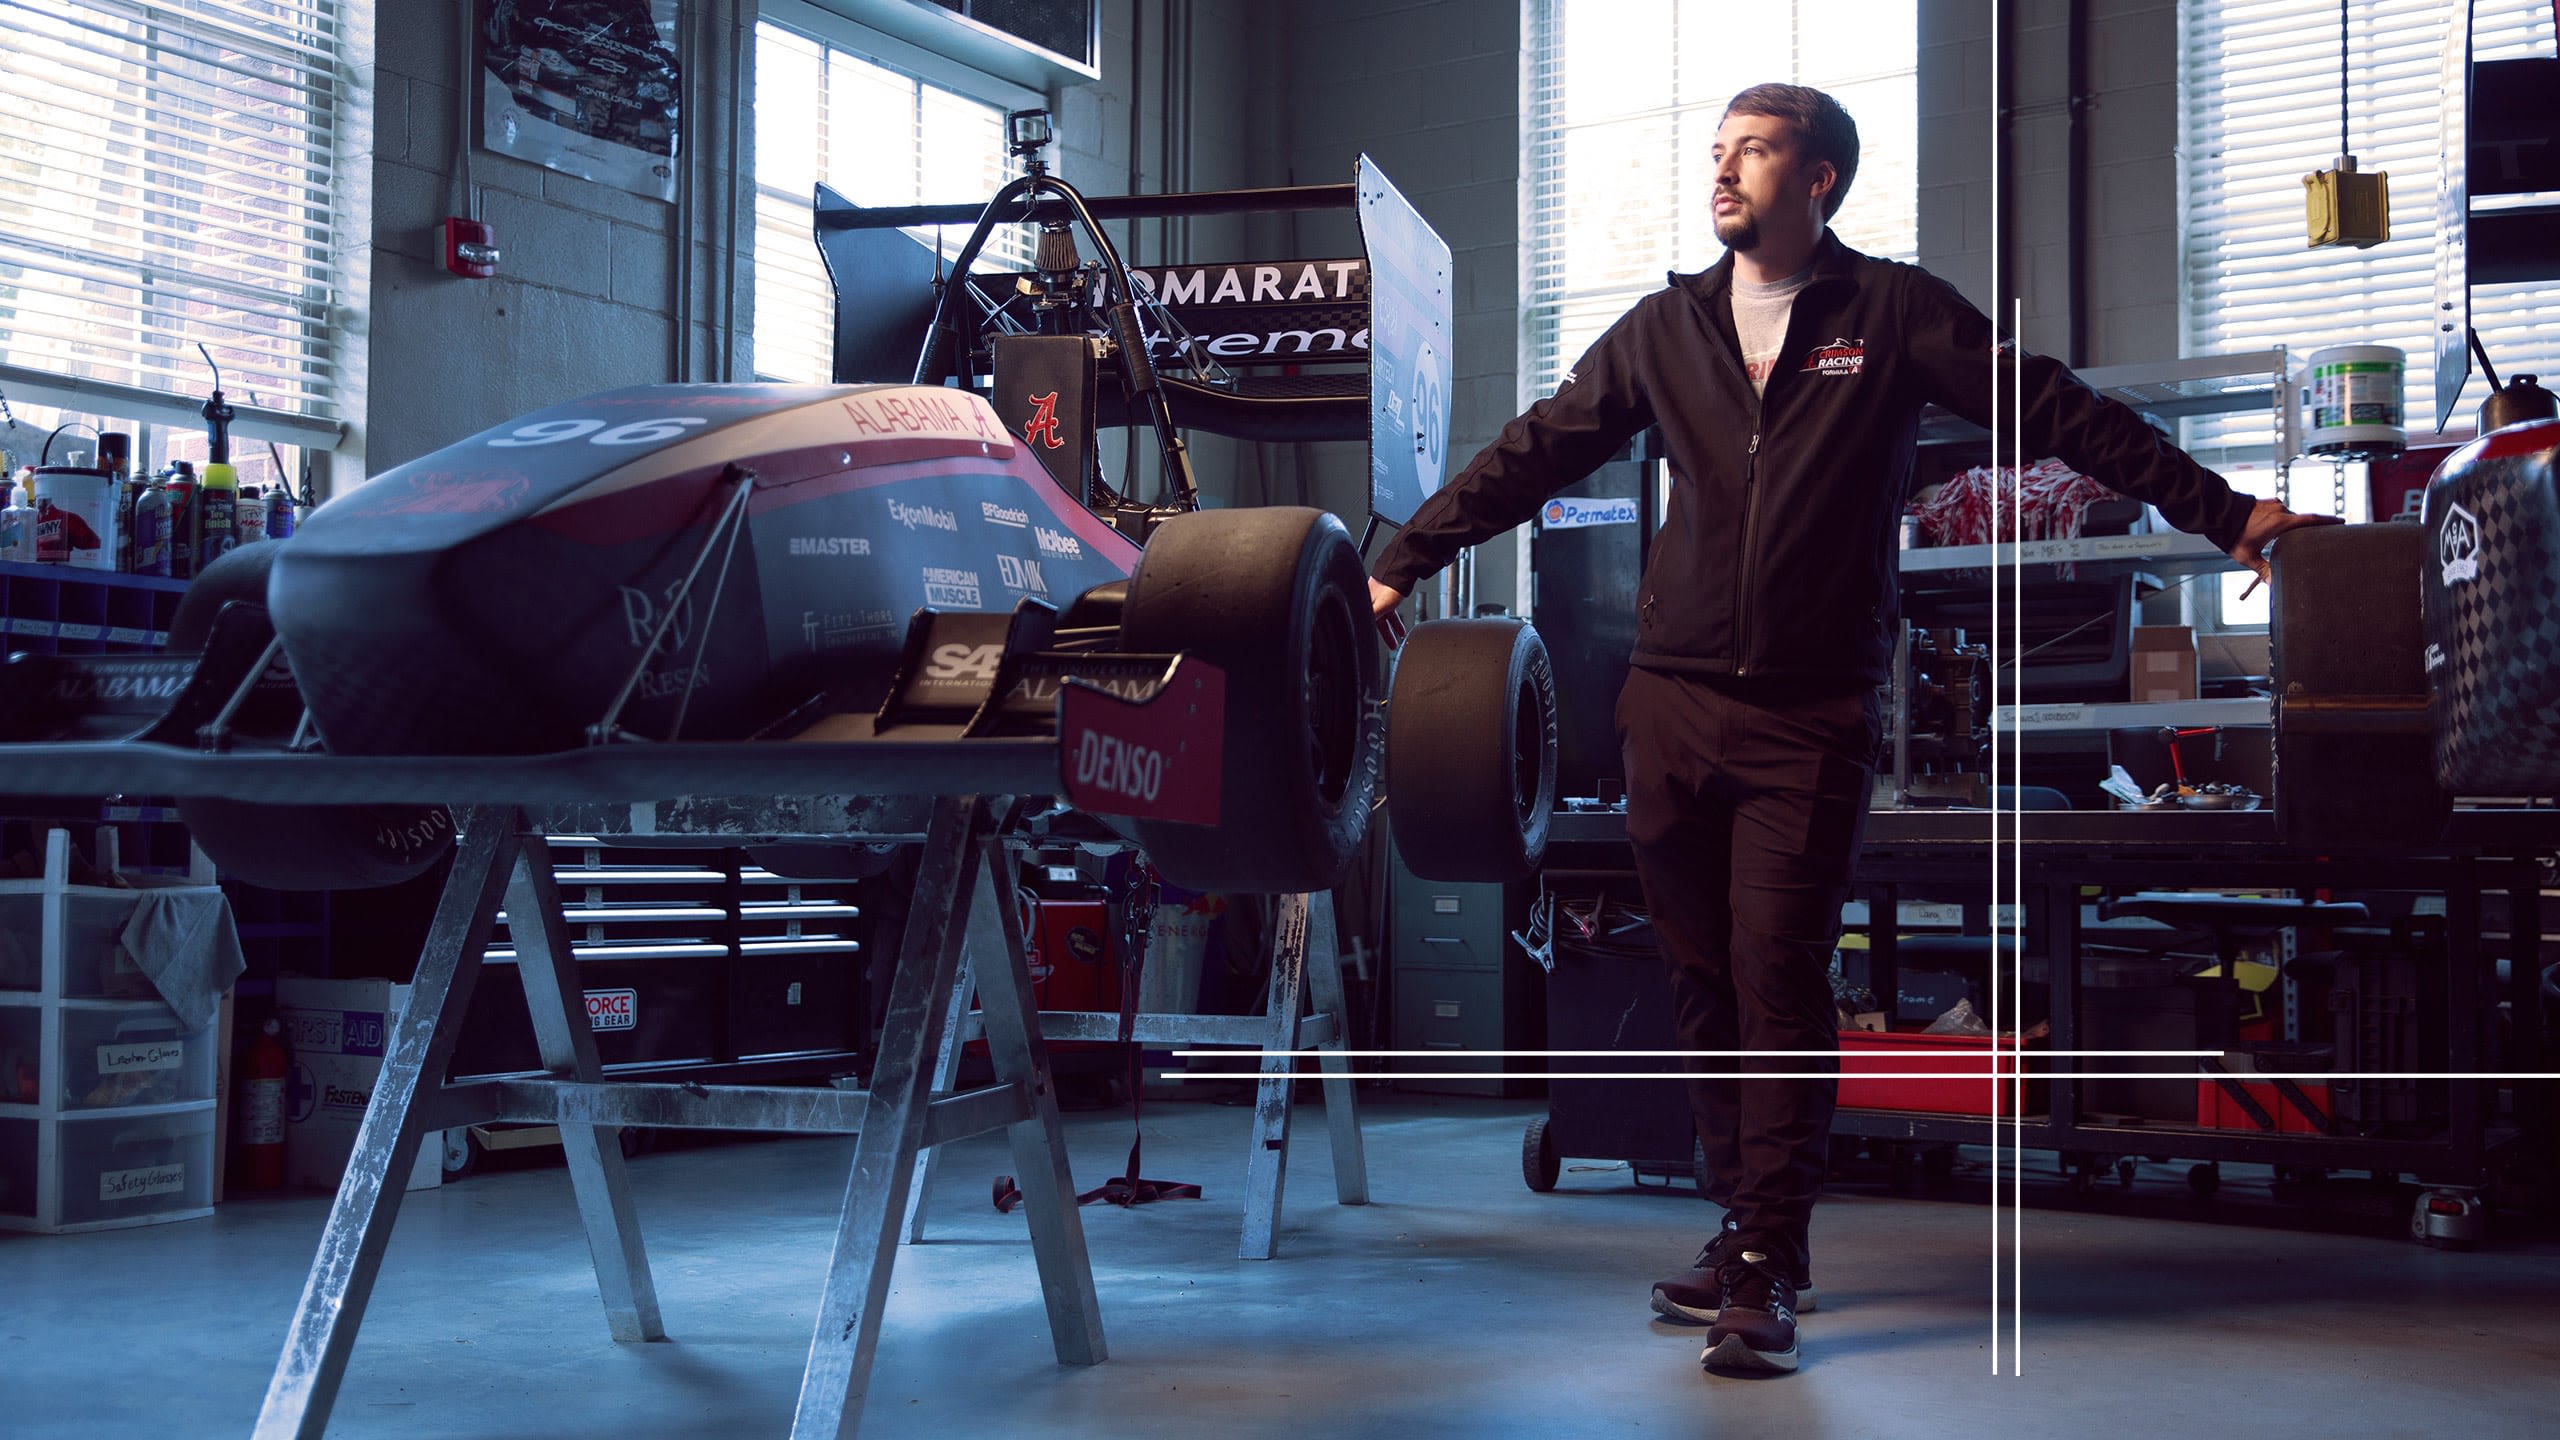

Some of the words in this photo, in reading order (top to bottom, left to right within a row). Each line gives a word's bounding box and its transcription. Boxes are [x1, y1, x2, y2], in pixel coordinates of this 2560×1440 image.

[576, 83, 608, 100] MONTE
[610, 93, 643, 110] CARLO
[1818, 347, 1864, 359] CRIMSON
[1818, 355, 1864, 368] RACING
[842, 397, 969, 436] ALABAMA
[1416, 369, 1440, 466] 96
[487, 416, 708, 448] 96
[204, 518, 231, 529] Finish
[887, 498, 959, 532] ExxonMobil
[981, 501, 1029, 525] BFGoodrich
[1565, 506, 1635, 524] Permatex
[1034, 526, 1081, 555] McAbee
[923, 566, 980, 587] AMERICAN
[928, 585, 979, 606] MUSCLE
[94, 662, 179, 674] UNIVERSITY
[1075, 727, 1163, 802] DENSO
[586, 995, 630, 1015] ORCE
[1896, 989, 1935, 1006] Frame
[604, 1014, 630, 1026] GEAR
[344, 1020, 383, 1048] AID
[323, 1085, 370, 1106] FASTEN
[107, 1173, 148, 1194] Safety
